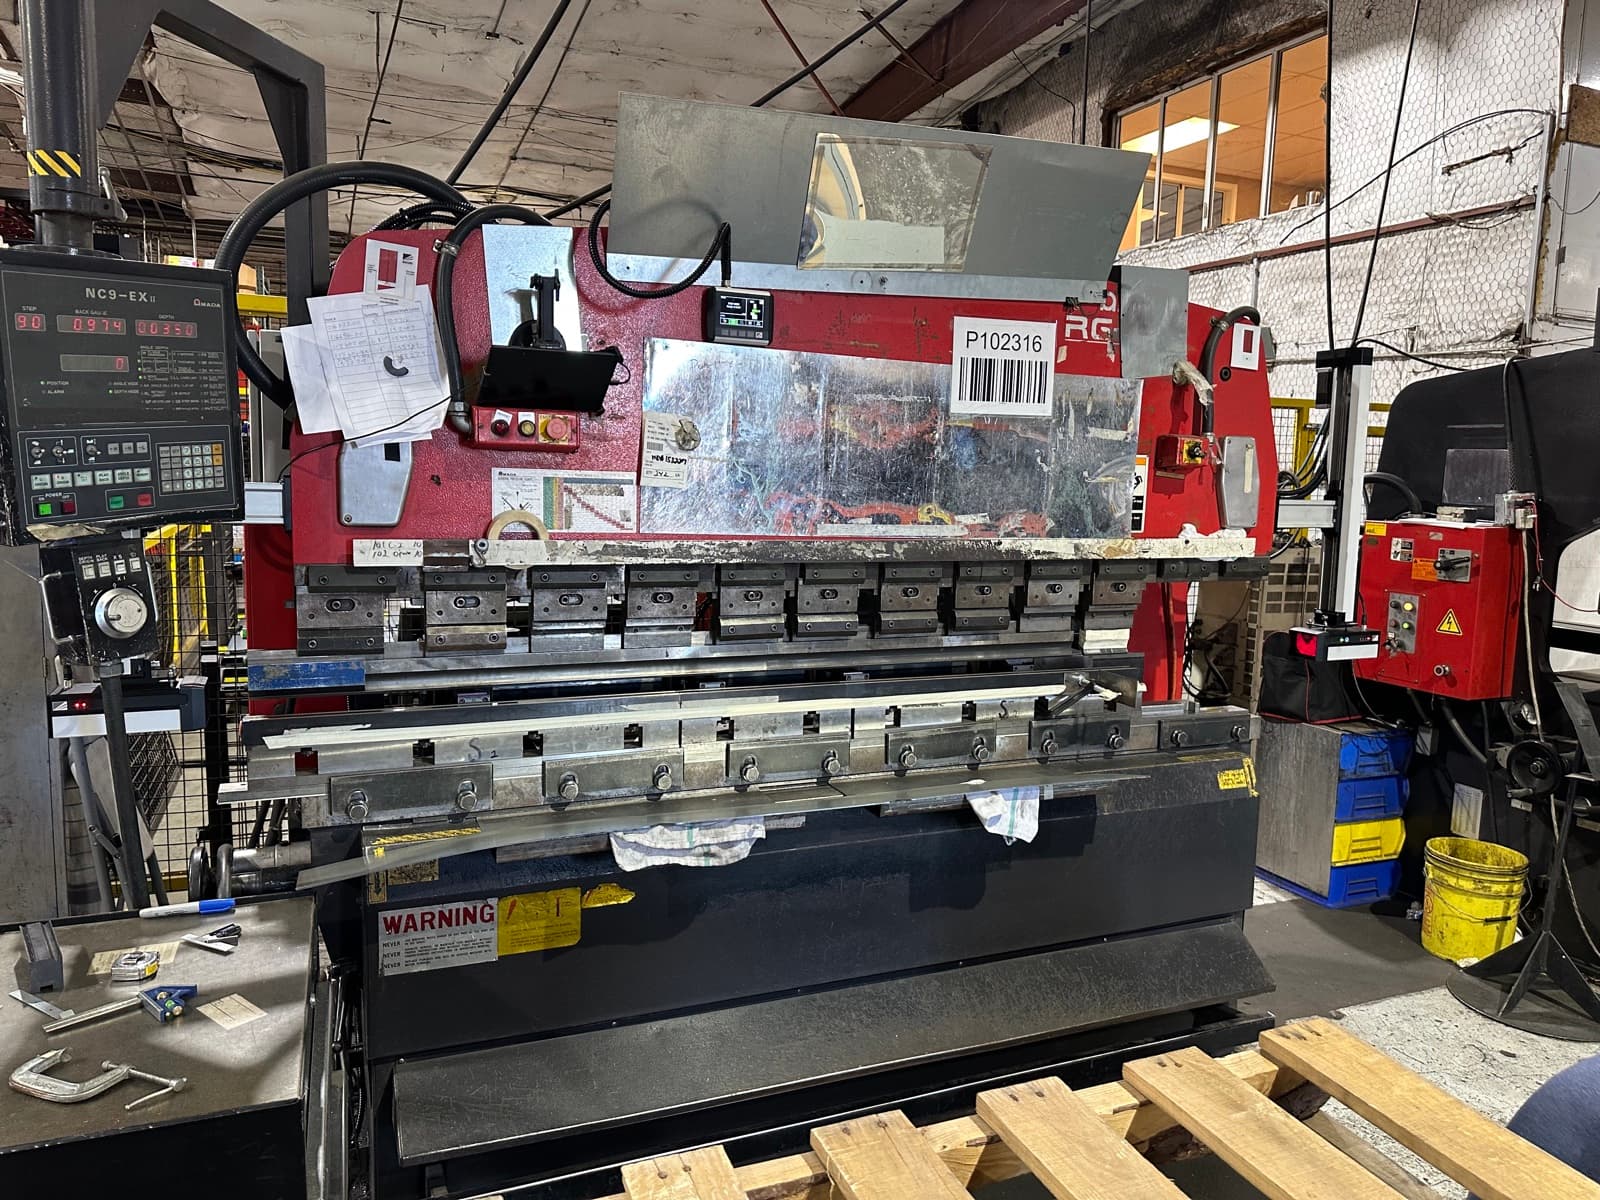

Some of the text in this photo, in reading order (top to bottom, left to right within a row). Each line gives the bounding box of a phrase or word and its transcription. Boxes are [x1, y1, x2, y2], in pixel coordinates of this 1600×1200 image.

[966, 331, 1042, 353] P102316
[383, 904, 495, 935] WARNING
[382, 951, 401, 959] NEVER
